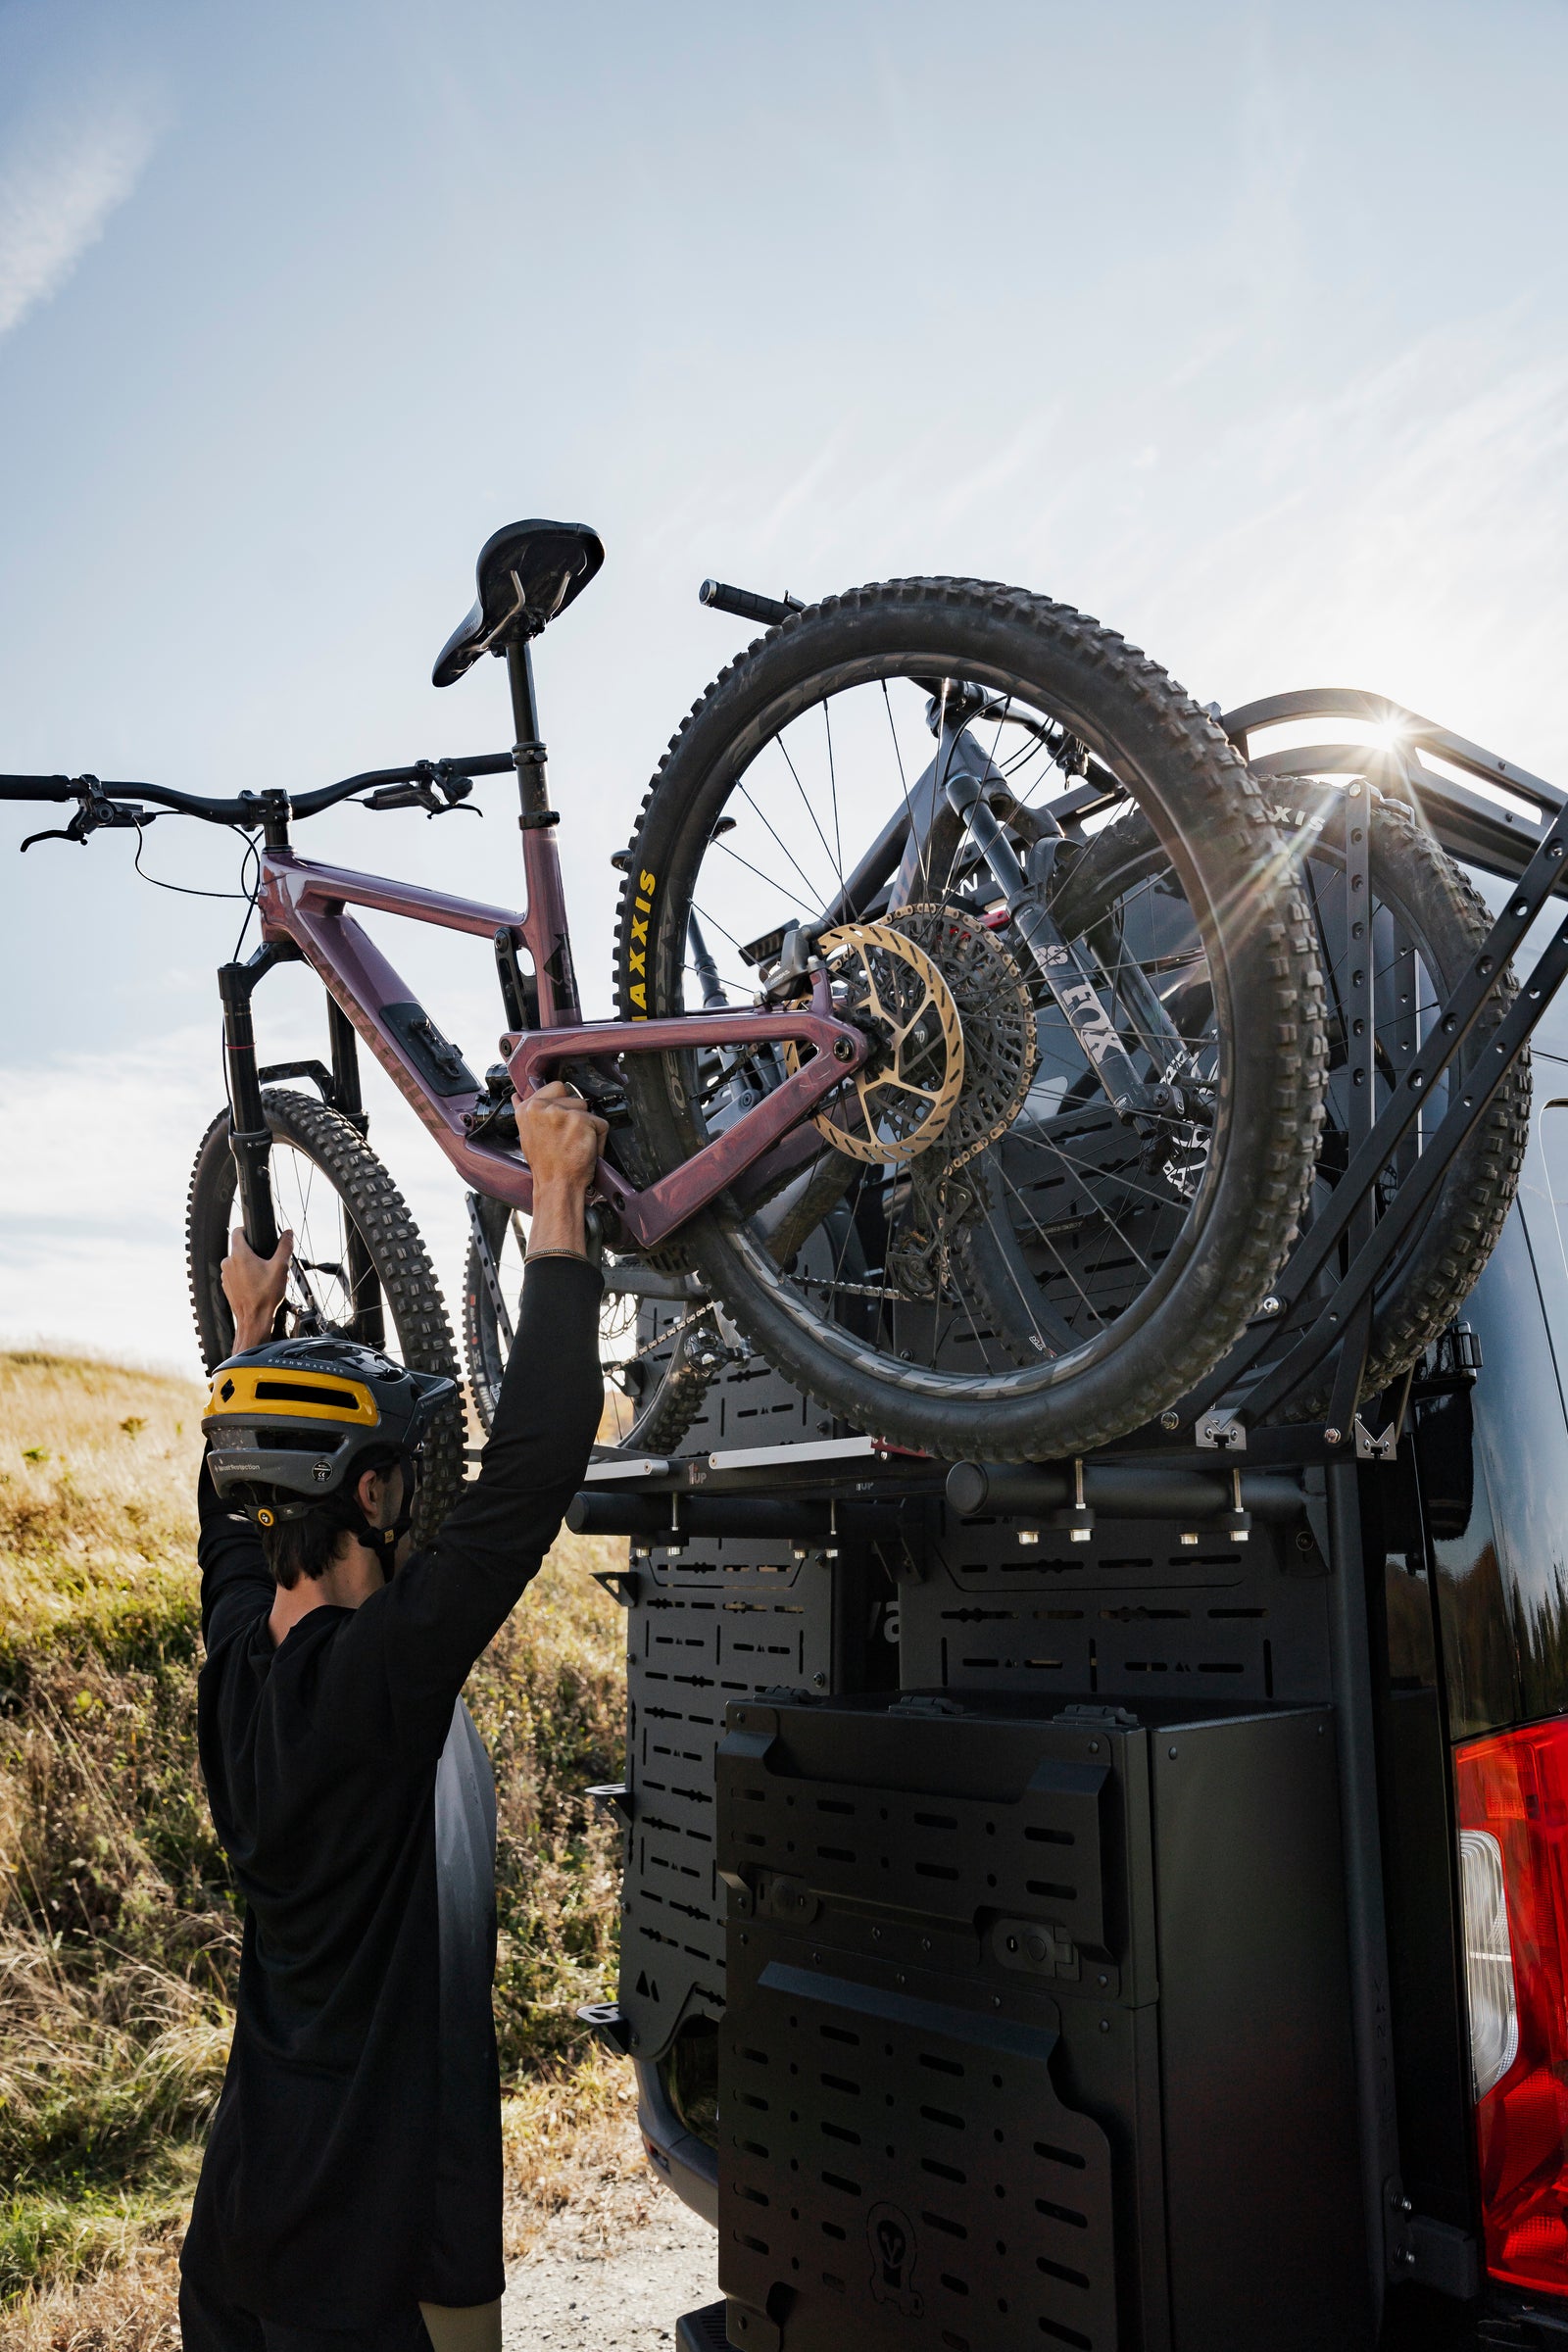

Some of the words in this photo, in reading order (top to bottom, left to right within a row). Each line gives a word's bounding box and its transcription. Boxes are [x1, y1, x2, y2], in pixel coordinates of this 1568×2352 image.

[1273, 805, 1326, 832] XIS
[629, 869, 657, 1021] AXXIS
[1060, 983, 1126, 1064] FOX
[688, 1462, 708, 1485] 1UP
